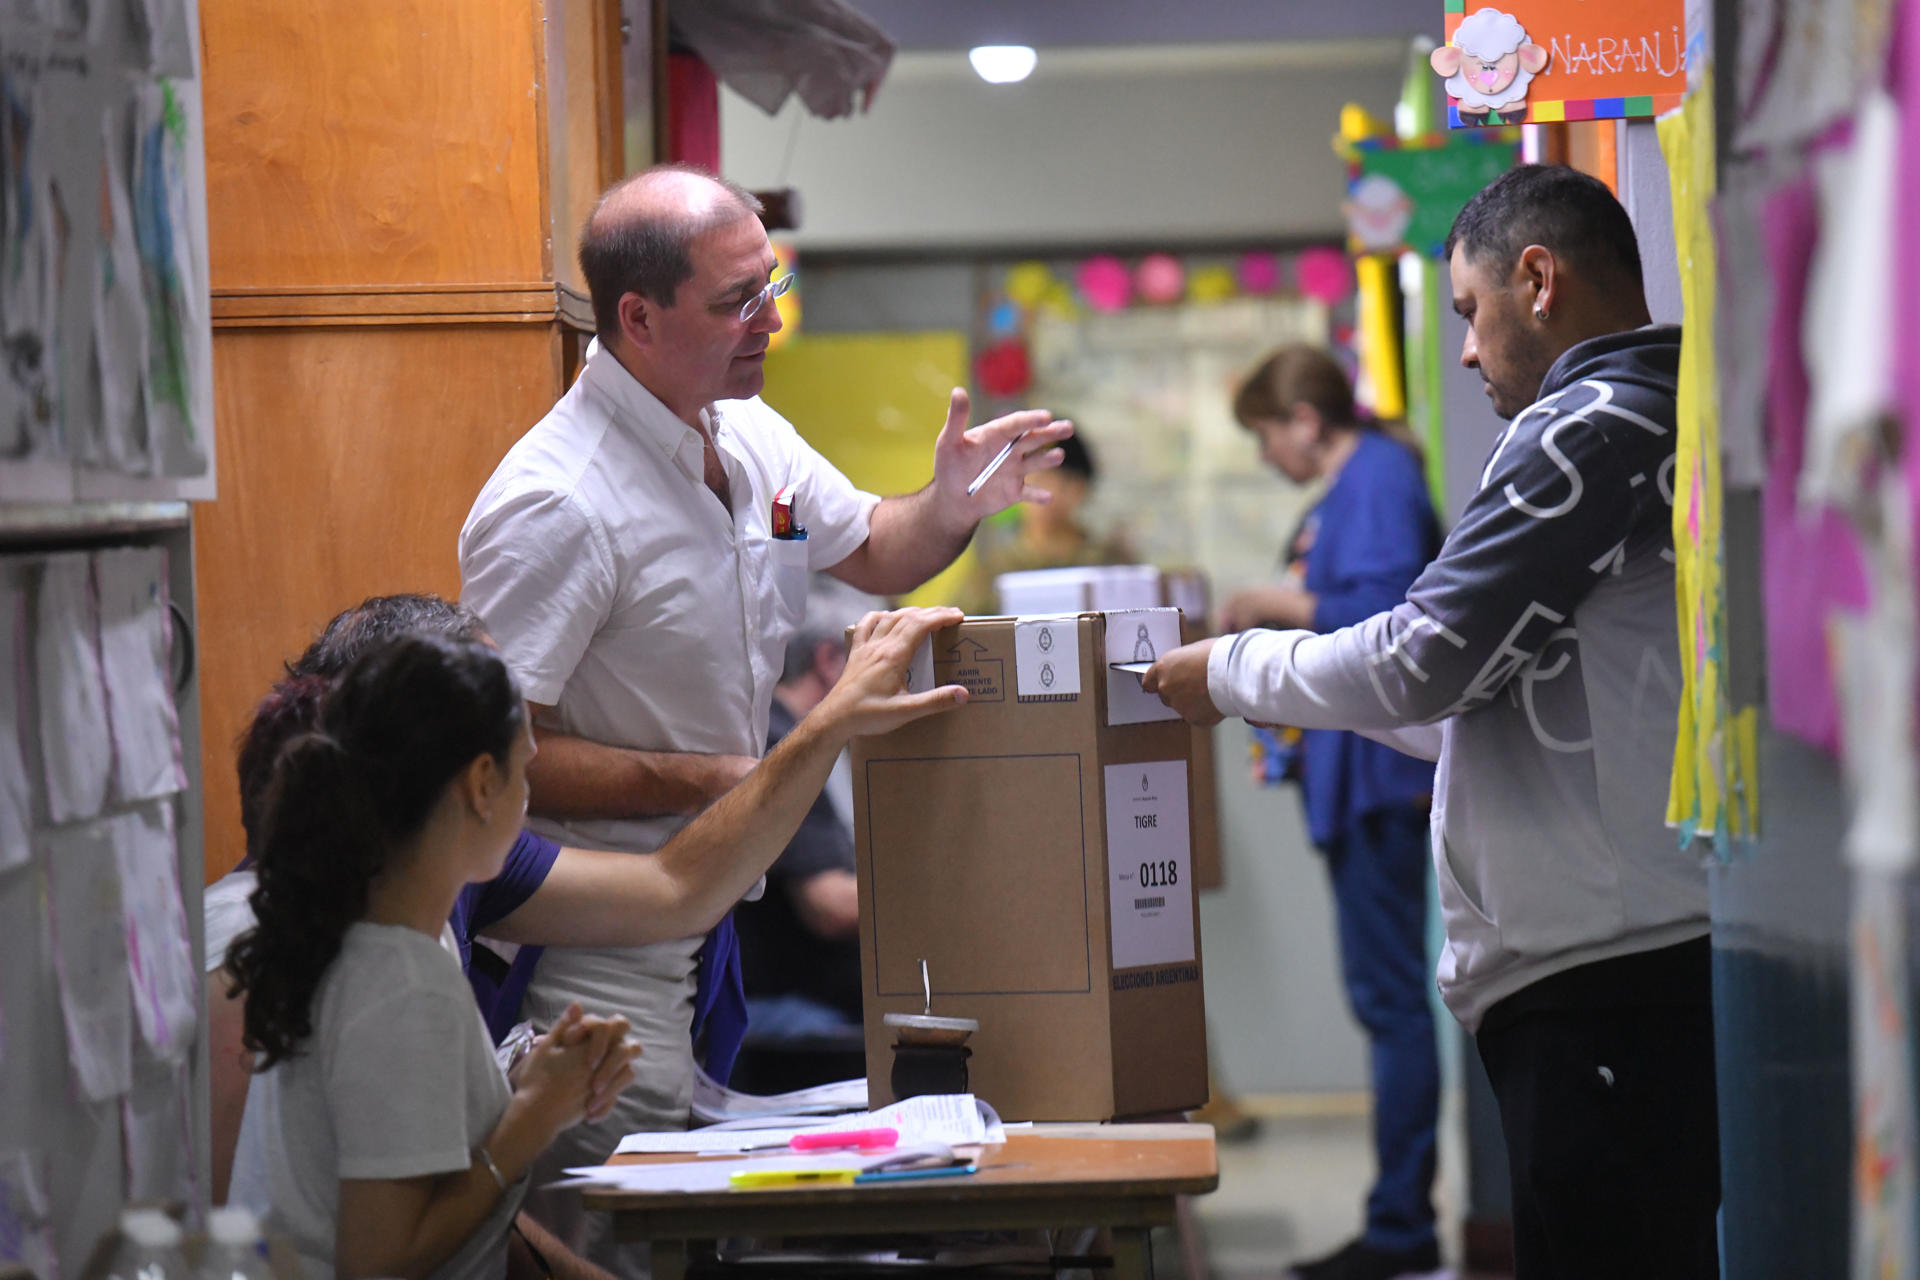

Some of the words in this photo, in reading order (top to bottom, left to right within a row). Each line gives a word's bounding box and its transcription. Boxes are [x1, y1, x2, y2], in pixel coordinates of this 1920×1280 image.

[958, 669, 980, 677] ABRIR
[978, 687, 997, 695] LADO
[1134, 814, 1158, 829] TIGRE
[1139, 860, 1178, 888] 0118
[1112, 970, 1154, 992] ELECCIONES
